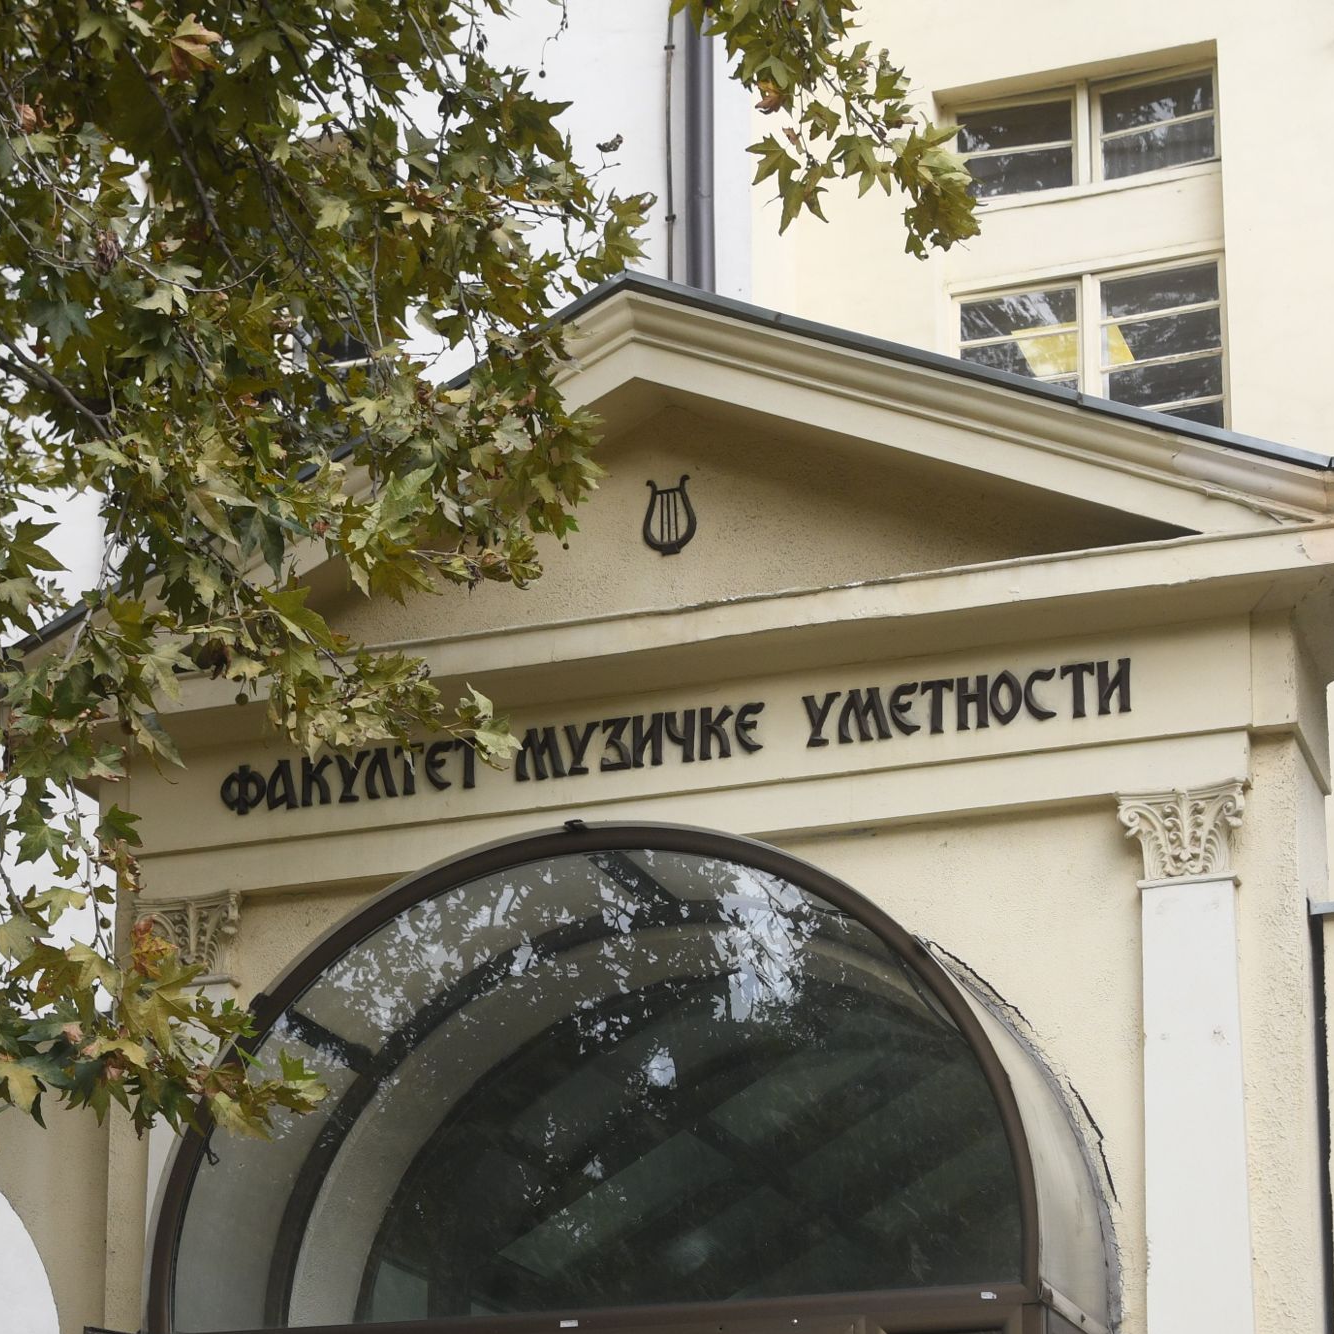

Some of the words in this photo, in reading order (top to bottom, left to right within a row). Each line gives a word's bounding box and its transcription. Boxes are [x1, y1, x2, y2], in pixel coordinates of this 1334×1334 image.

[220, 737, 479, 816] ФАКУЛТЕТ
[513, 701, 765, 782] МУЗИЧКЕ
[801, 656, 1134, 749] УМЕТНОСТИ
